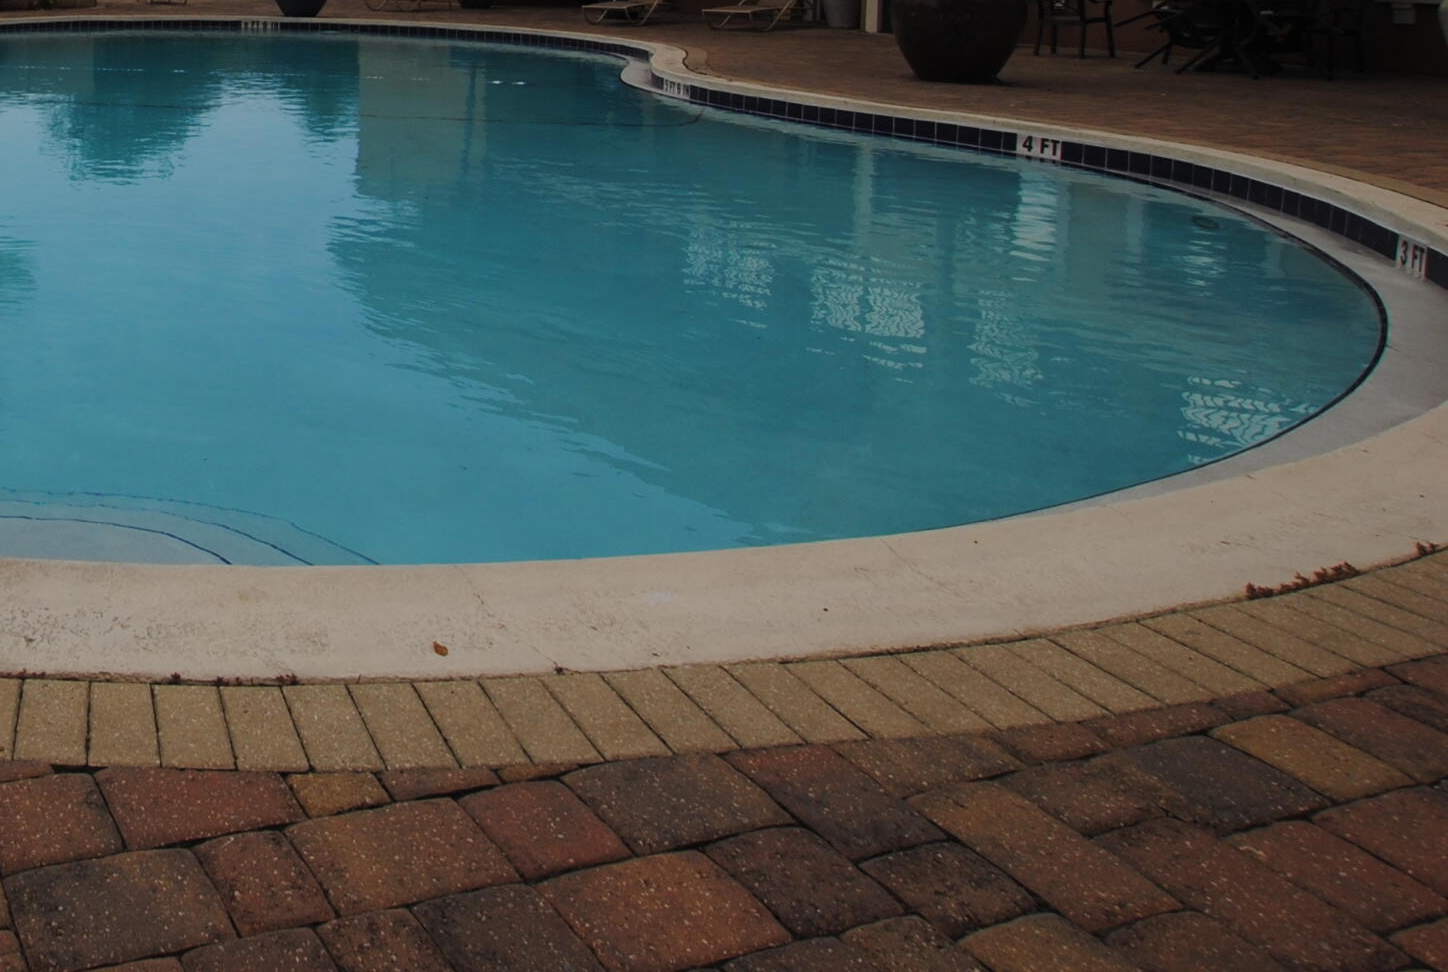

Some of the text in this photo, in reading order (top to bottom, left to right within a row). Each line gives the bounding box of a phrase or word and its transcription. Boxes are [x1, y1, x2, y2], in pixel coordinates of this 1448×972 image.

[669, 81, 676, 92] FT
[1021, 135, 1060, 156] 4 FT
[1400, 239, 1425, 273] 3 FT
